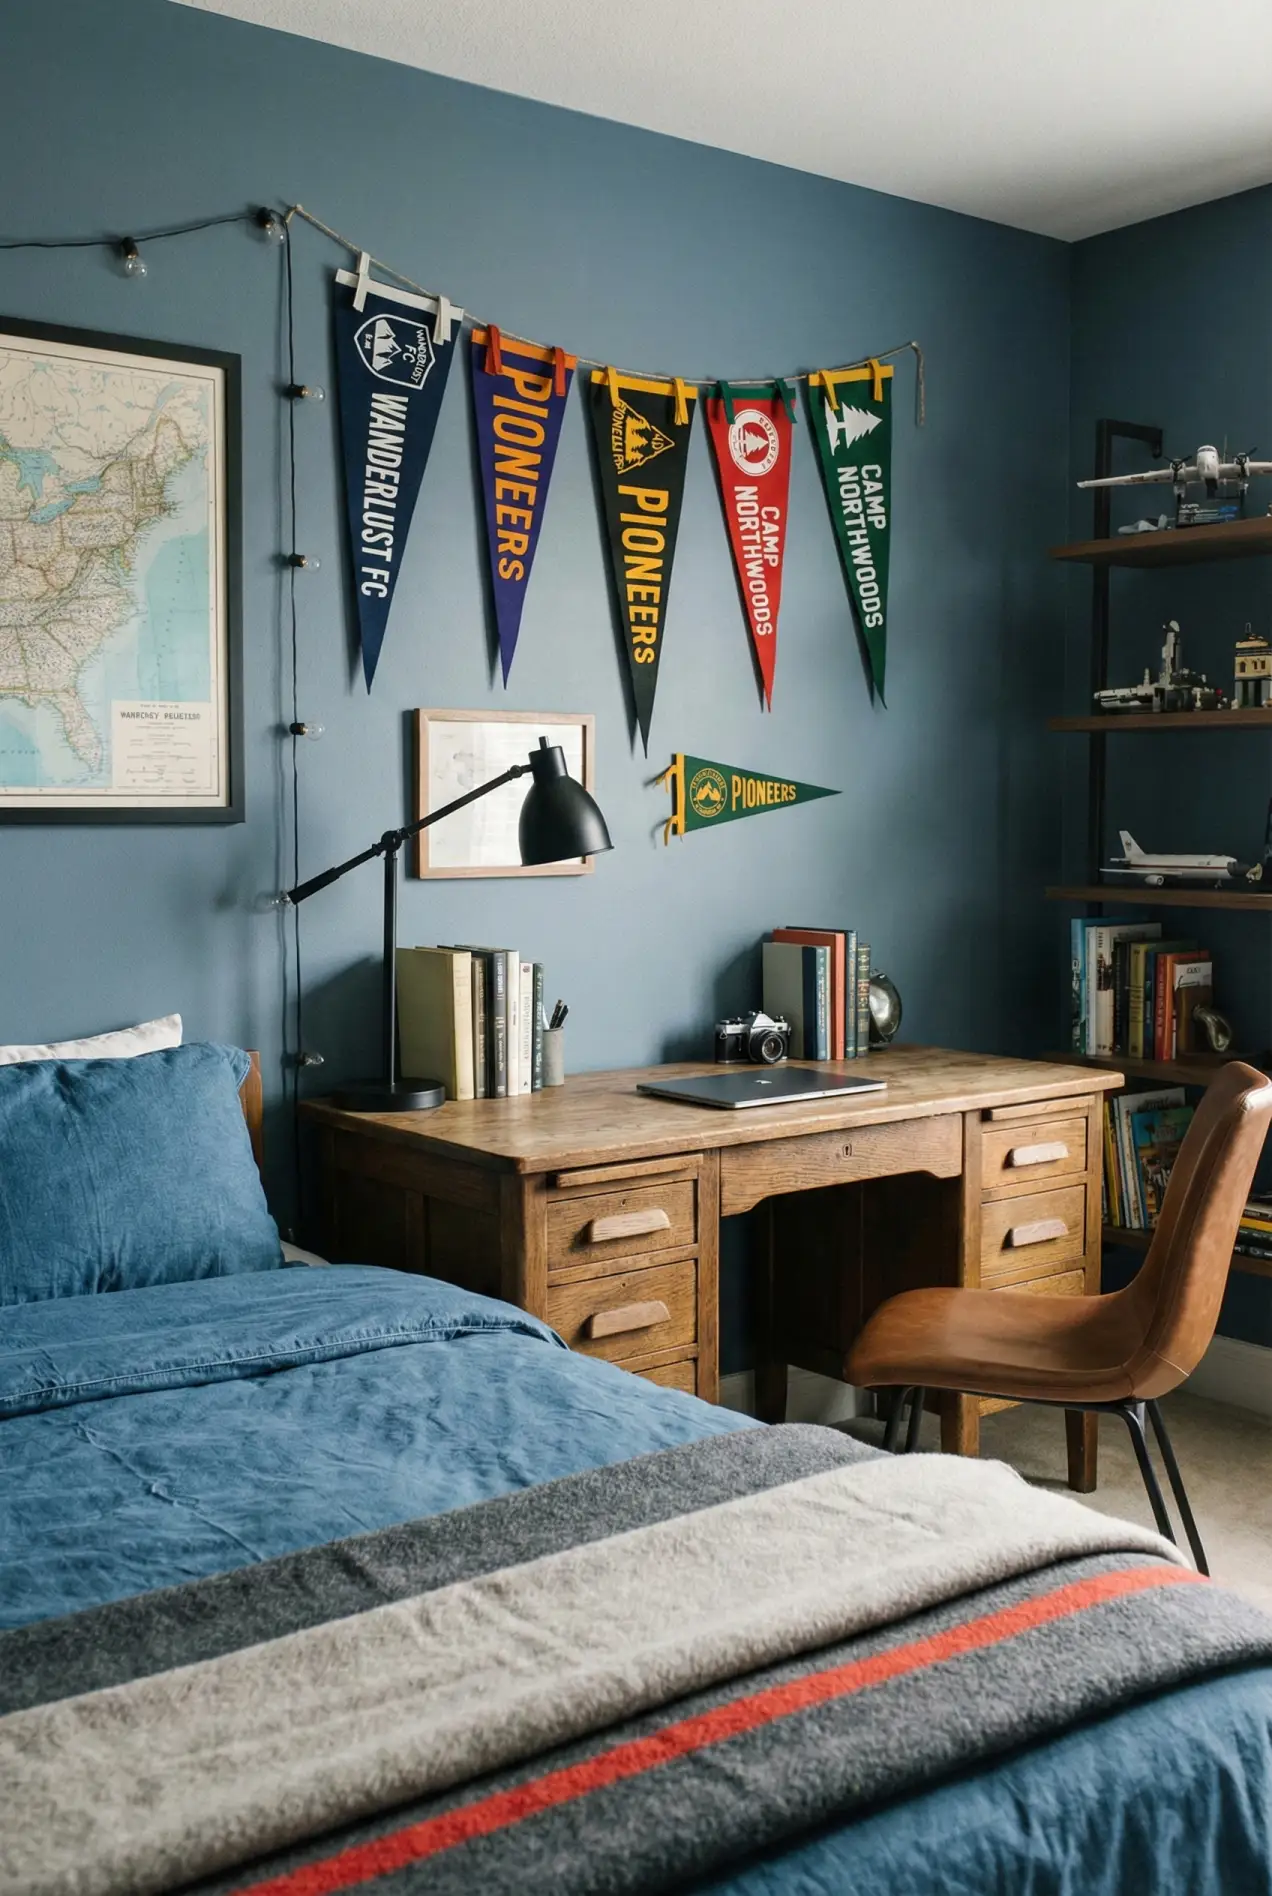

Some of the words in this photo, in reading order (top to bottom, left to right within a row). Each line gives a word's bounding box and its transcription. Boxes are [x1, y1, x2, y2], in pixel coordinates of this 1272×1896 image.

[402, 344, 417, 363] FC
[362, 392, 409, 562] WANDERLUST
[492, 365, 553, 581] PIONEERS
[861, 464, 887, 530] CAMP
[361, 567, 390, 598] FC
[617, 485, 669, 664] PIONEERS
[734, 485, 773, 636] NORTHWOODS
[760, 506, 780, 567] CAMP
[836, 466, 884, 628] NORTHWOODS
[731, 774, 797, 812] PIONEERS
